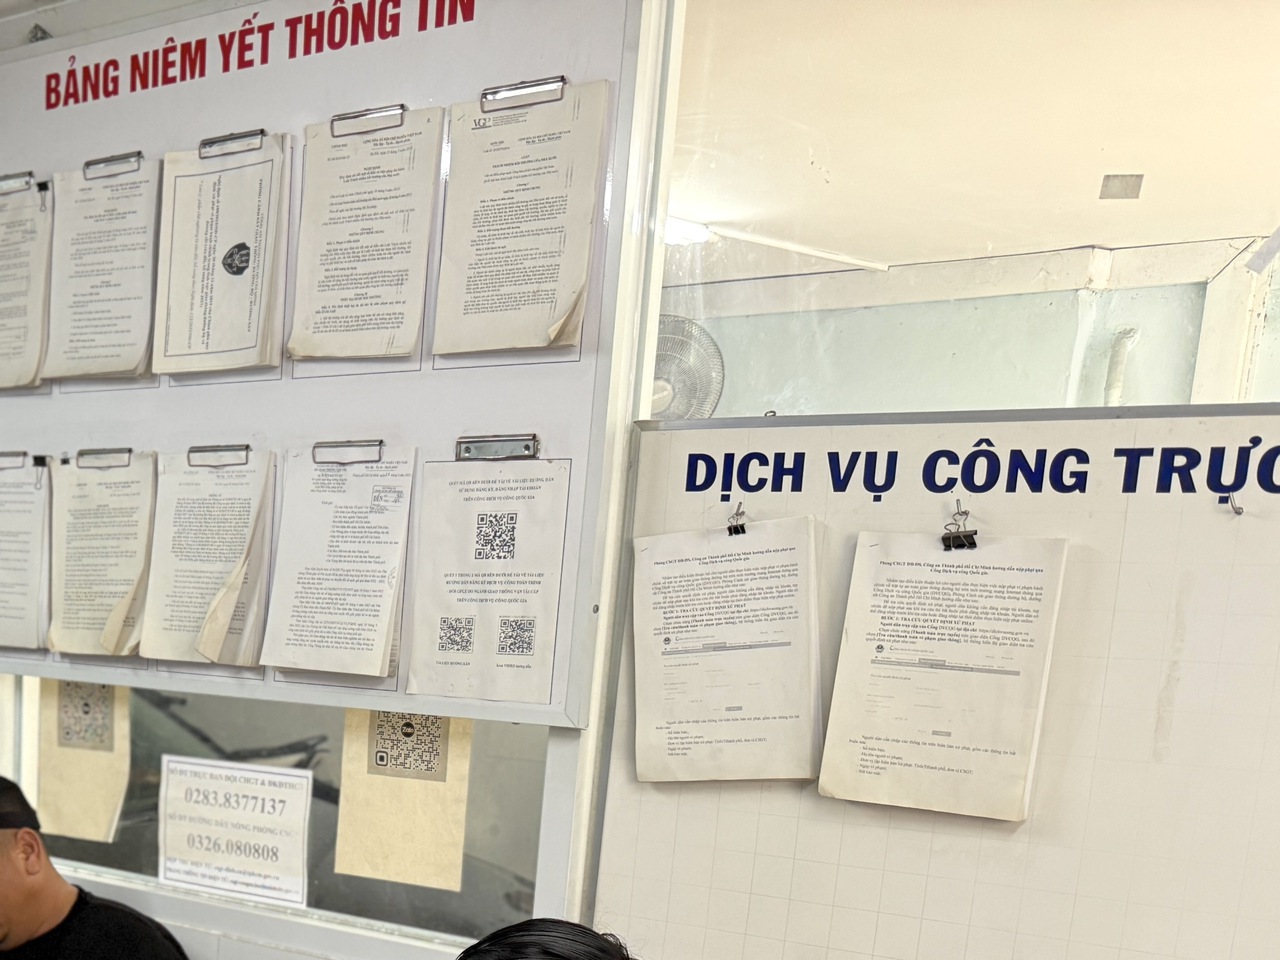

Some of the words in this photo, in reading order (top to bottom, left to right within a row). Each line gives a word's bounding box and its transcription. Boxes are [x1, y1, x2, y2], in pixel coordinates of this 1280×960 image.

[45, 55, 119, 110] BẢNG
[129, 36, 208, 93] NIÊM
[218, 12, 275, 73] YẾT
[284, 0, 402, 60] THÔNG
[684, 450, 806, 502] DỊCH
[827, 450, 900, 502] VỤ
[921, 437, 1091, 495] CÔNG
[183, 786, 286, 816] 0283.8377137
[185, 832, 280, 862] 0326.080808
